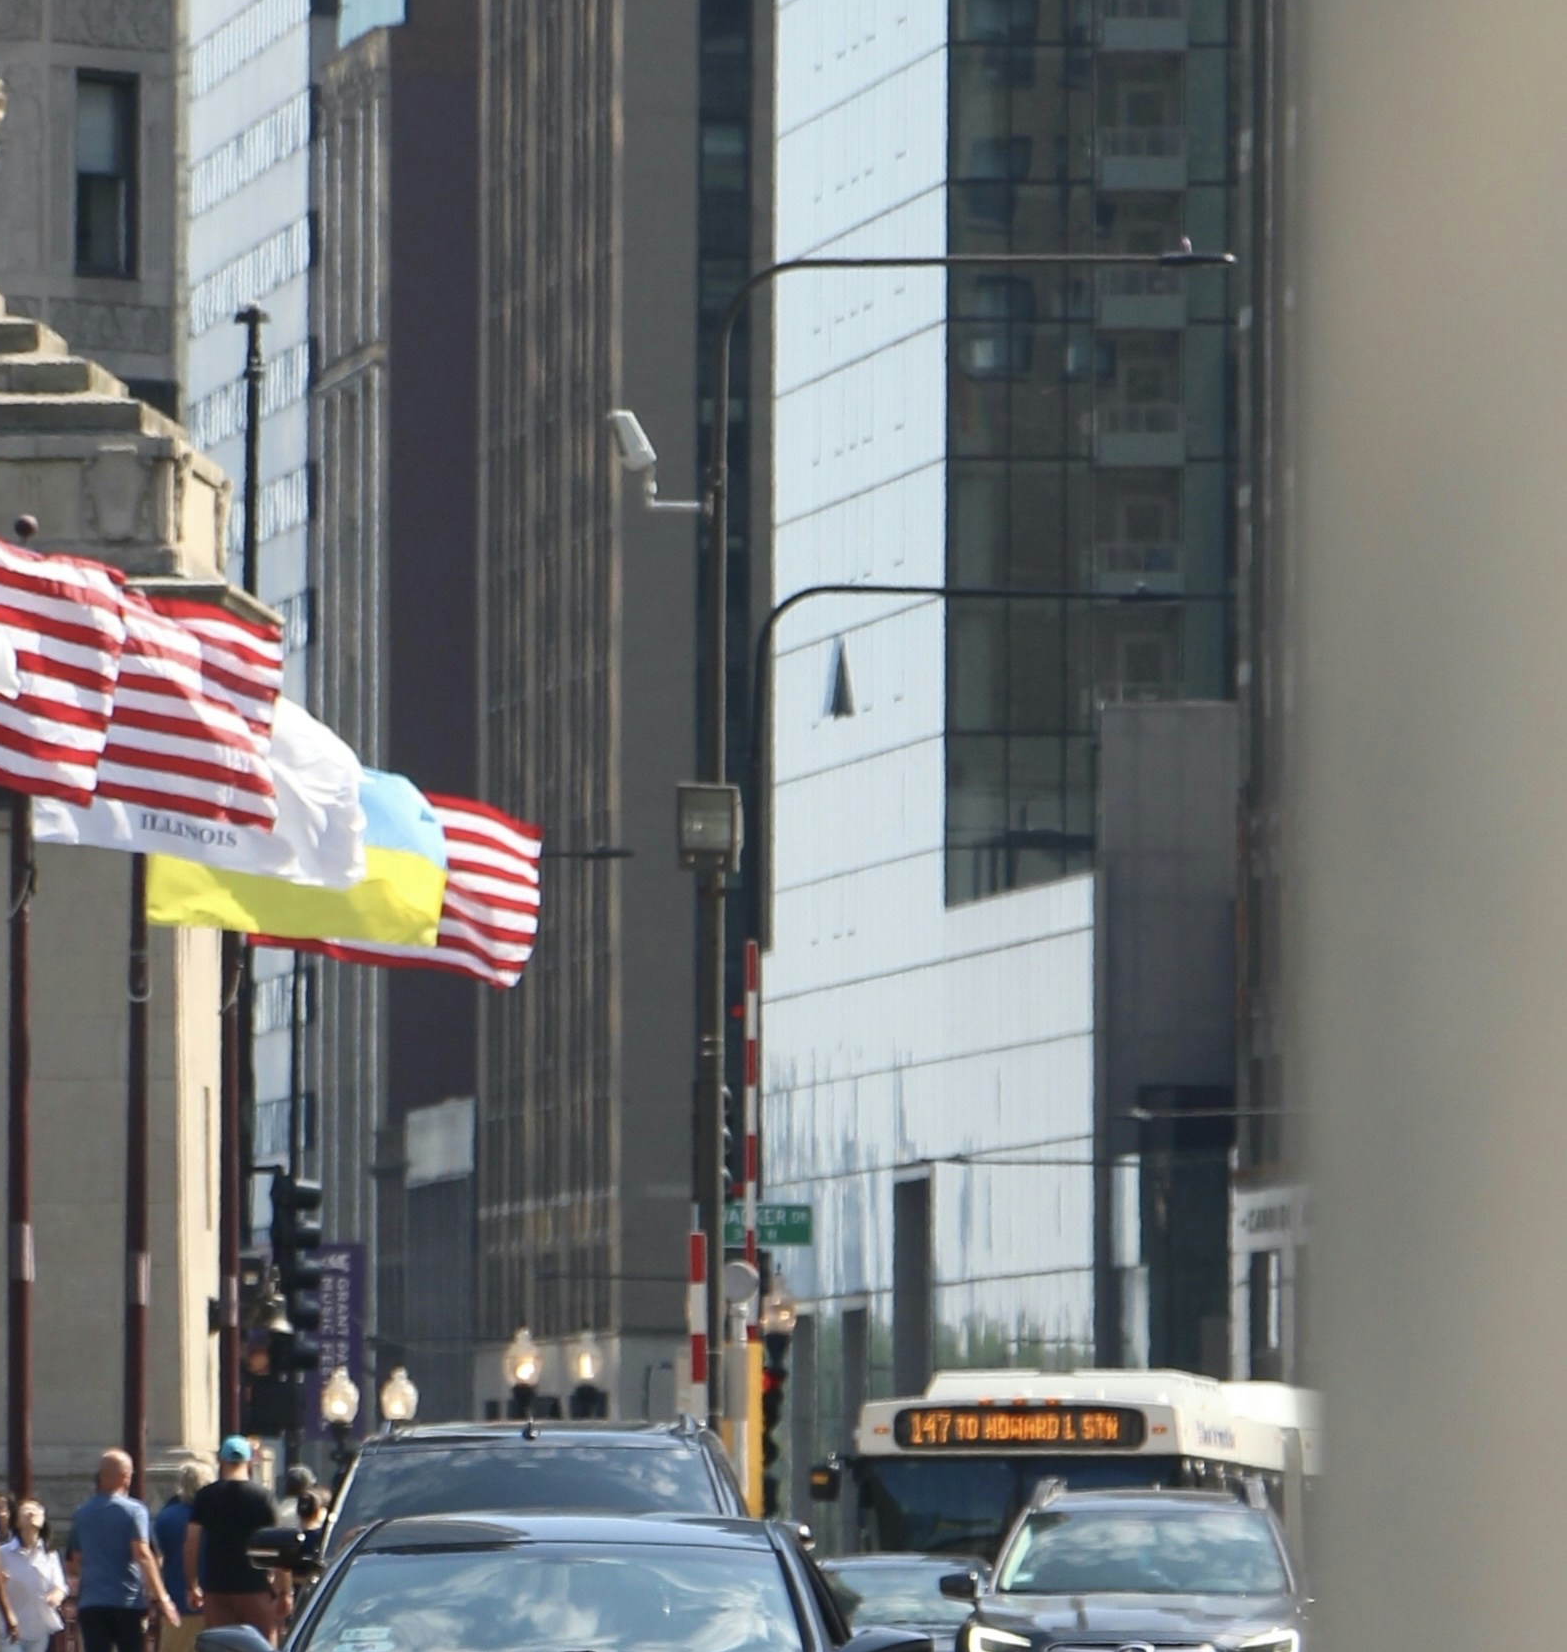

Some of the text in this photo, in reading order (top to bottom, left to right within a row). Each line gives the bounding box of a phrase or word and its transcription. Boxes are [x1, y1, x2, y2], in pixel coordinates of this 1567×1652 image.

[140, 812, 238, 847] ILLINOIS
[321, 1277, 334, 1336] MUSIC
[337, 1277, 350, 1337] GRANT
[910, 1411, 951, 1444] 147
[955, 1414, 979, 1440] TO
